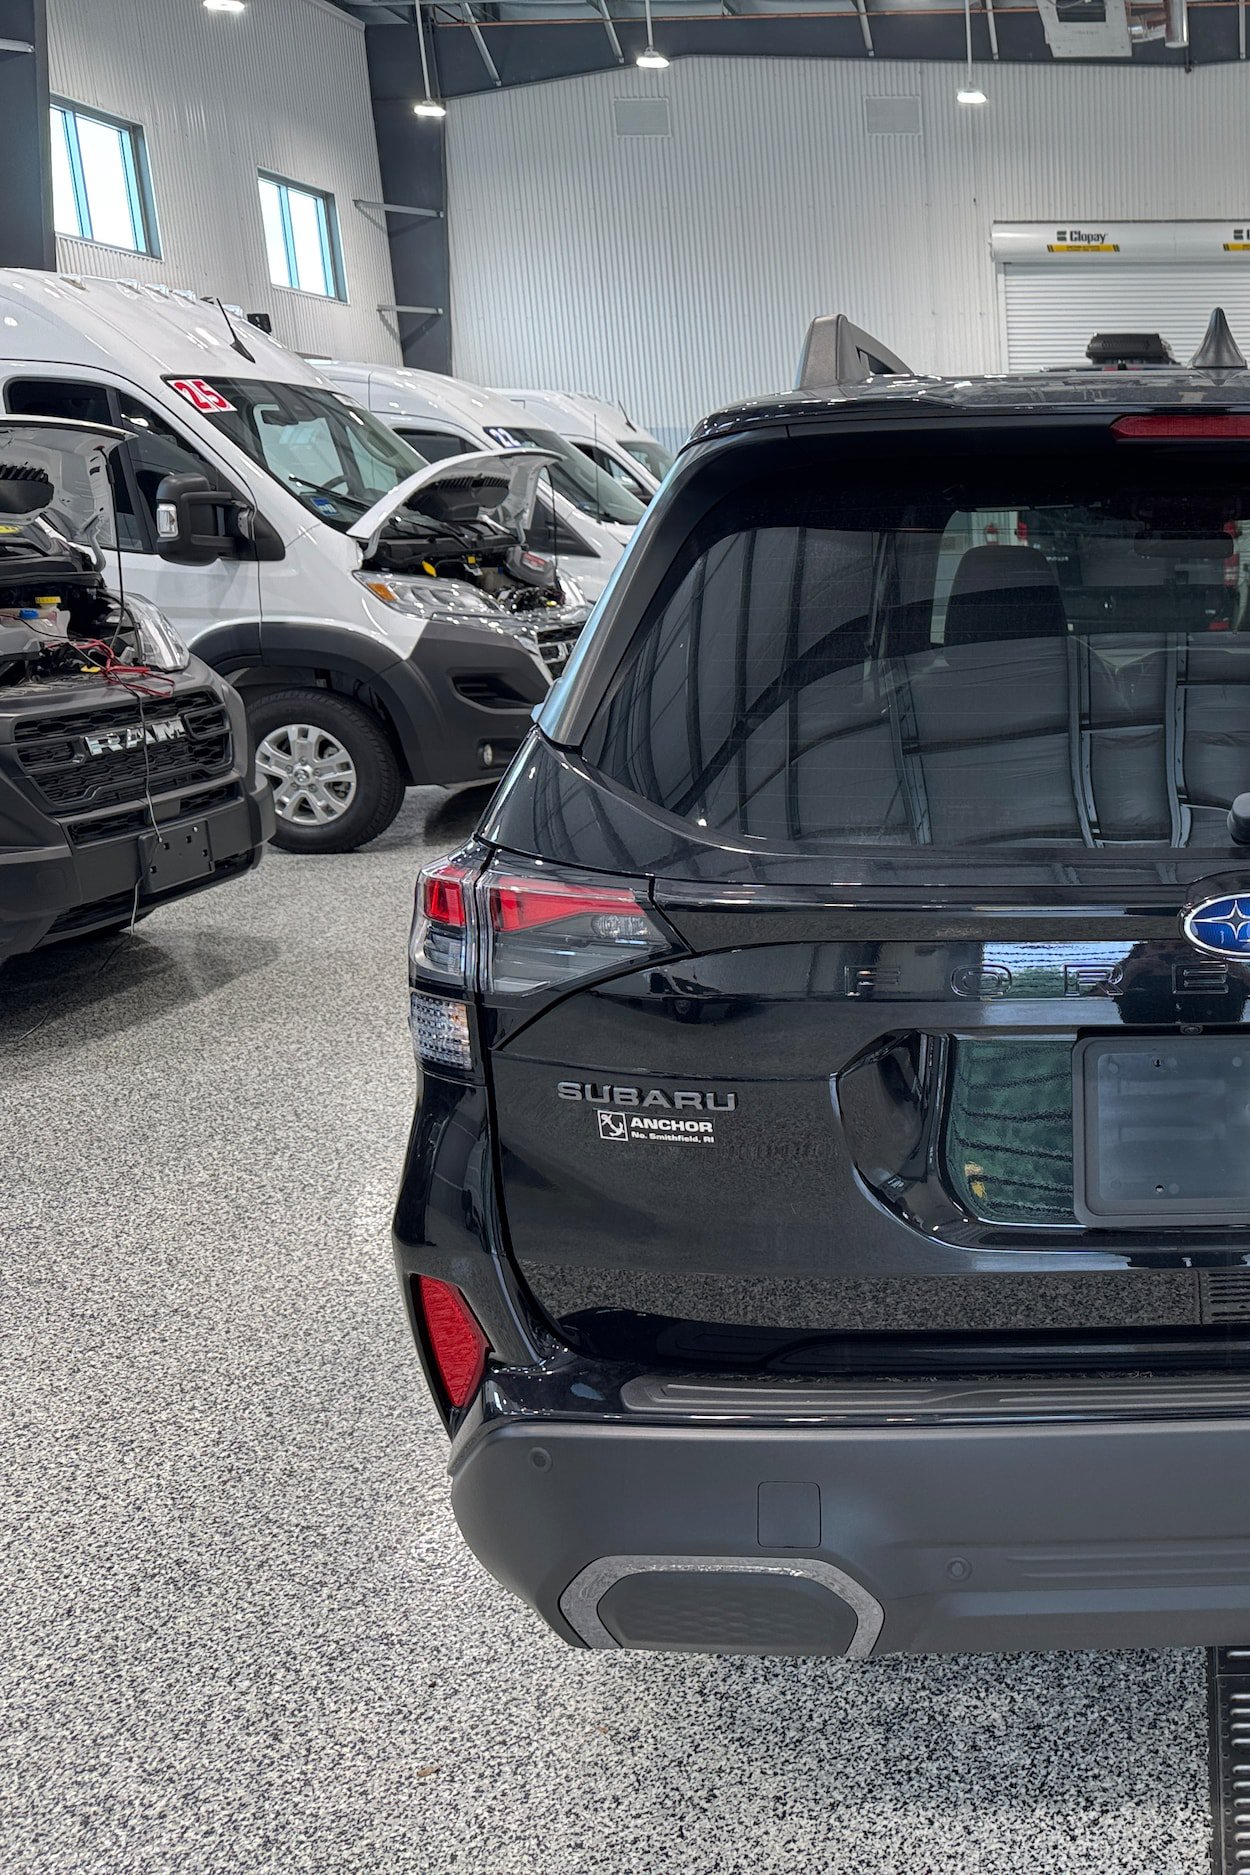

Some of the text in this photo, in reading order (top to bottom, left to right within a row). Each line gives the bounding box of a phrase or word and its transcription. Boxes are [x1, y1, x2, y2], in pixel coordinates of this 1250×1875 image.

[1070, 230, 1106, 244] Clopay
[174, 381, 227, 409] 25
[85, 717, 186, 756] RAM
[557, 1081, 737, 1112] SUBARU
[630, 1116, 713, 1133] ANCHOR
[631, 1130, 715, 1143] No. Smithfield, RI
